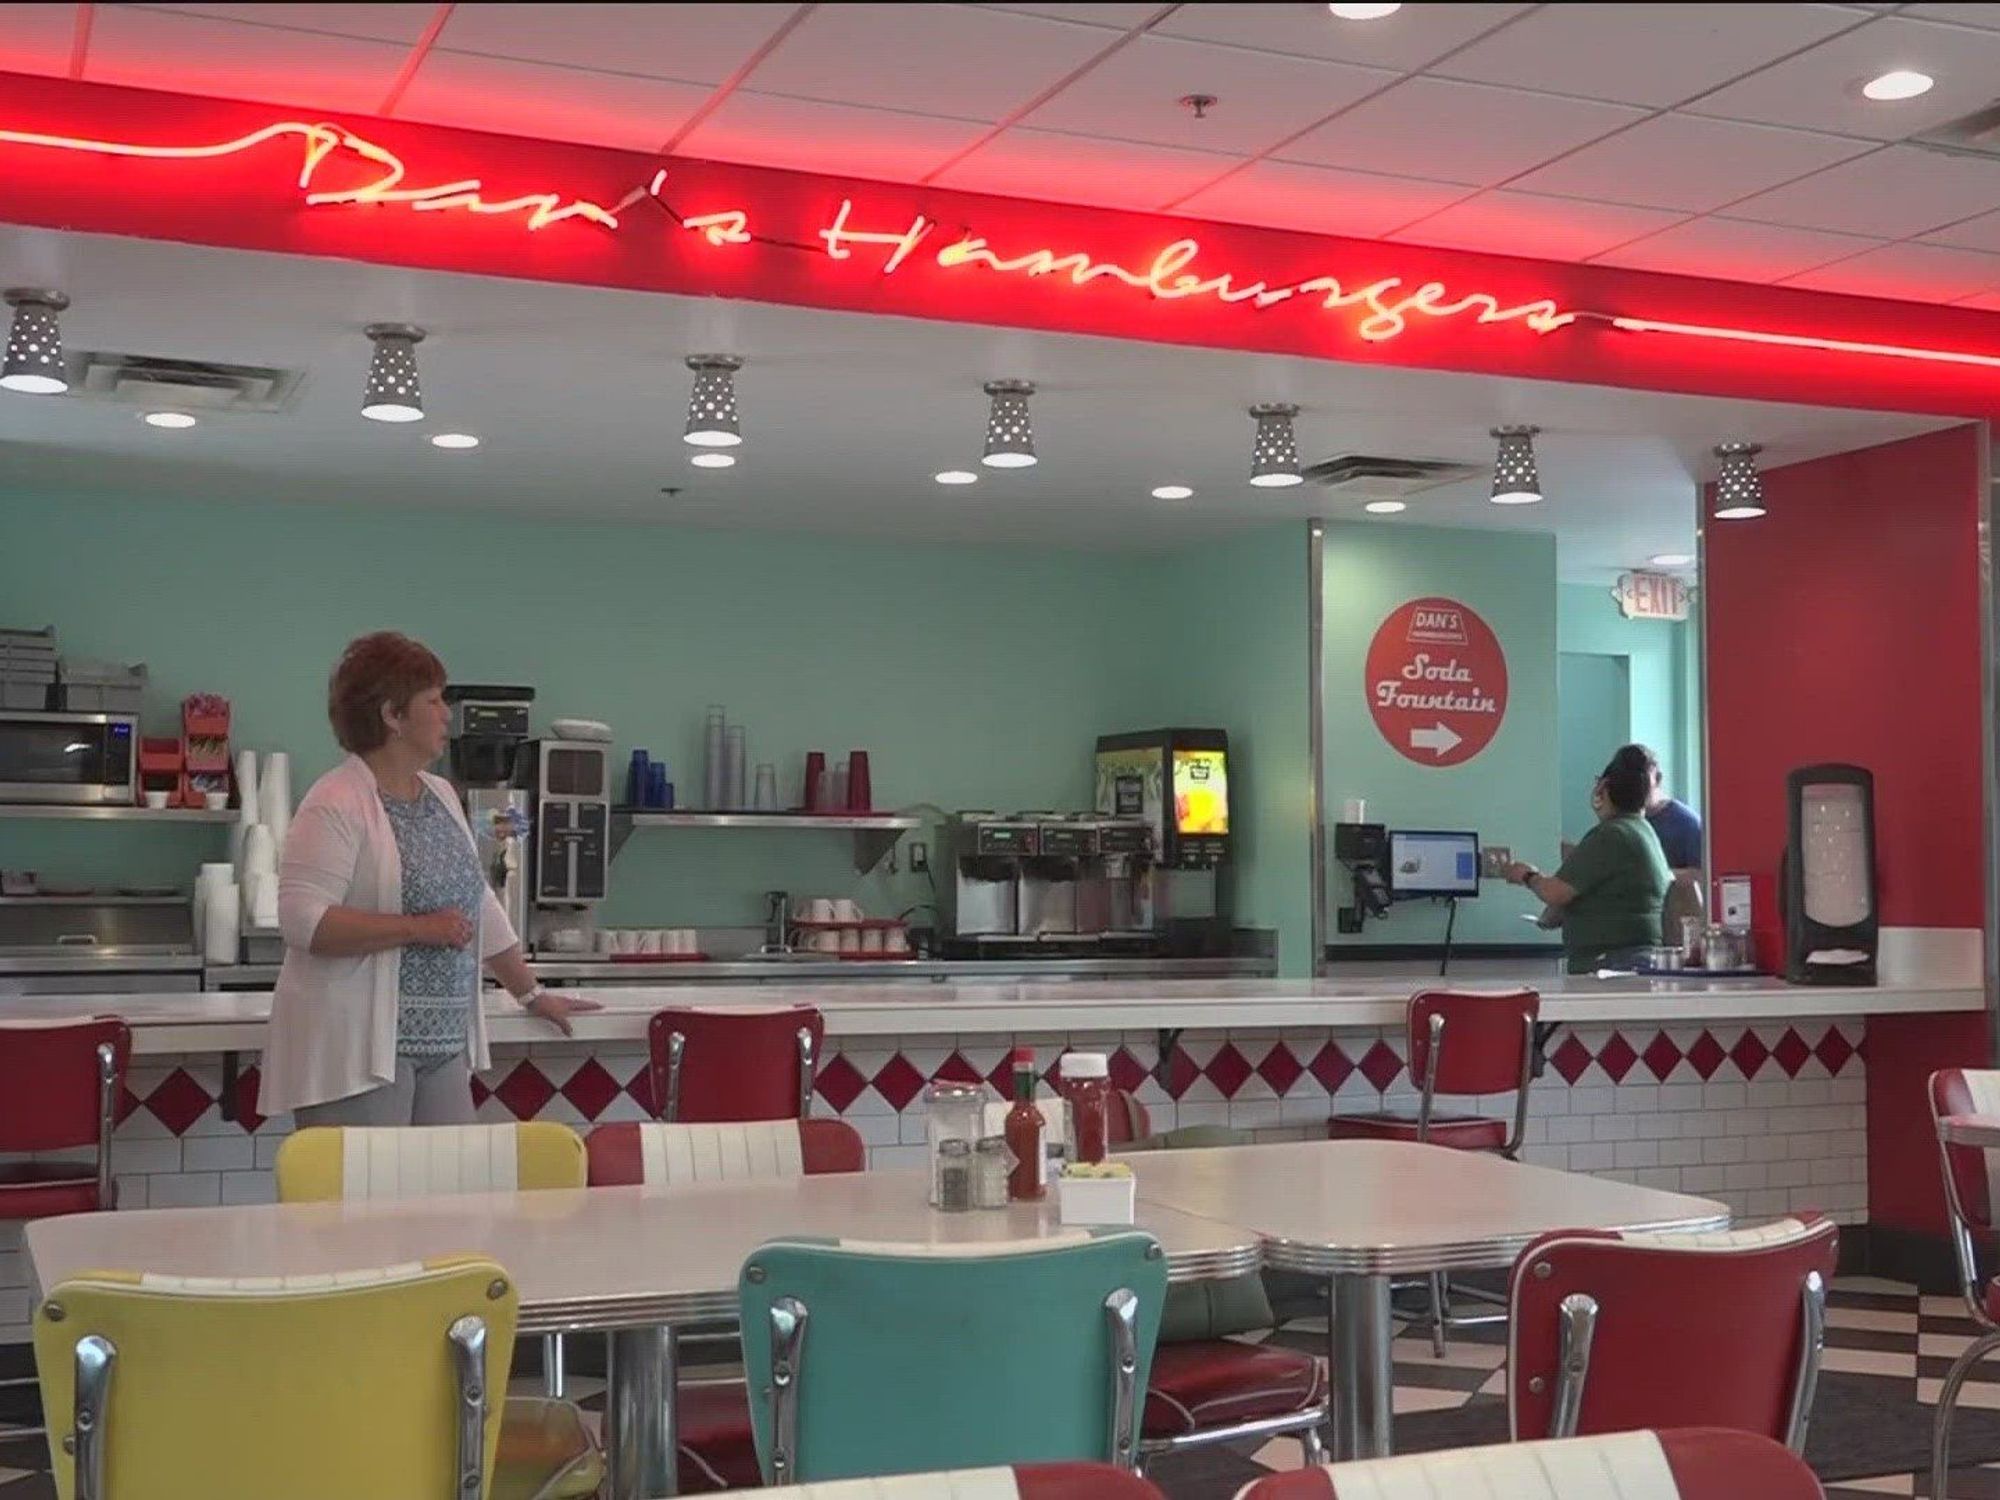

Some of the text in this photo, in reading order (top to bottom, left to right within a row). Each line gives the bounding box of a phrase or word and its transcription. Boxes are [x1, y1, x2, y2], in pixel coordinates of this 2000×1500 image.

[299, 121, 1574, 342] Dan's Hamburgers
[1633, 575, 1682, 615] EXIT
[1415, 611, 1458, 629] DAN'S
[1402, 653, 1473, 682] Soda
[1376, 681, 1496, 712] Fountain
